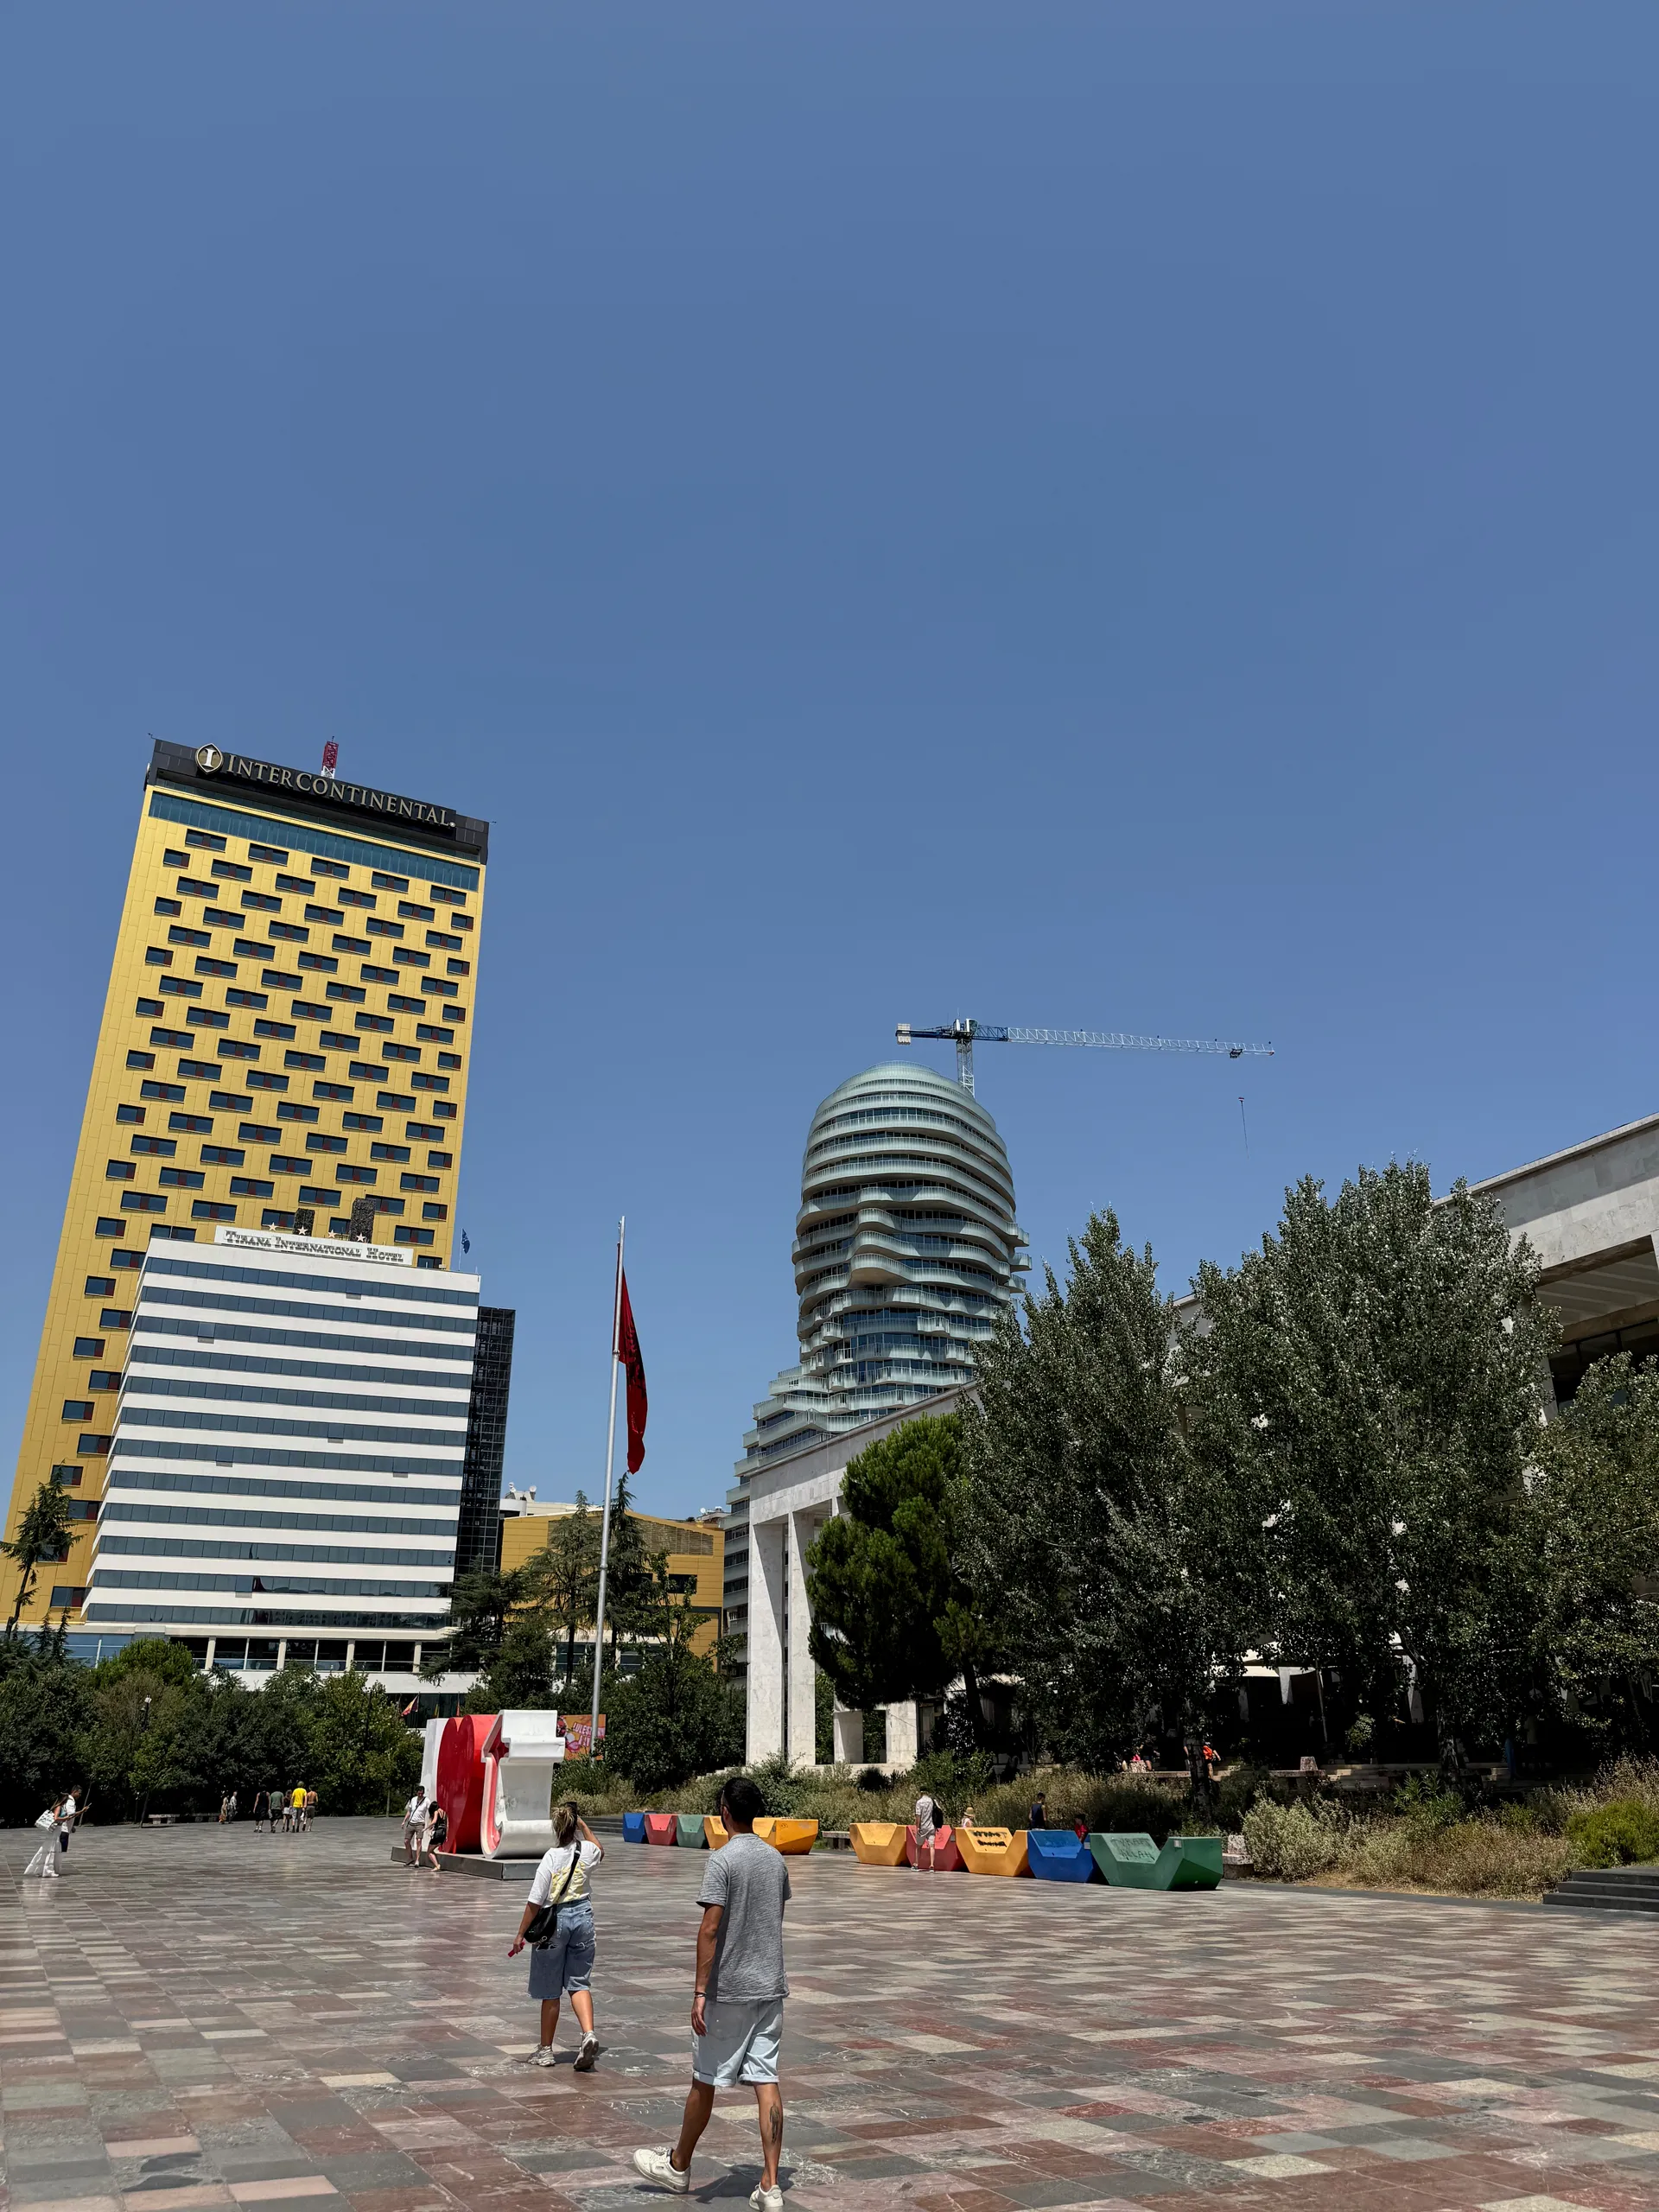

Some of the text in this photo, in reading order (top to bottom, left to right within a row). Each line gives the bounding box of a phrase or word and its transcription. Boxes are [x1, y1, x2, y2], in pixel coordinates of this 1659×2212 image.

[226, 753, 449, 827] INTERCONTINENTAL
[226, 1230, 404, 1262] TIRANA INTERNATIONAL HOTEL
